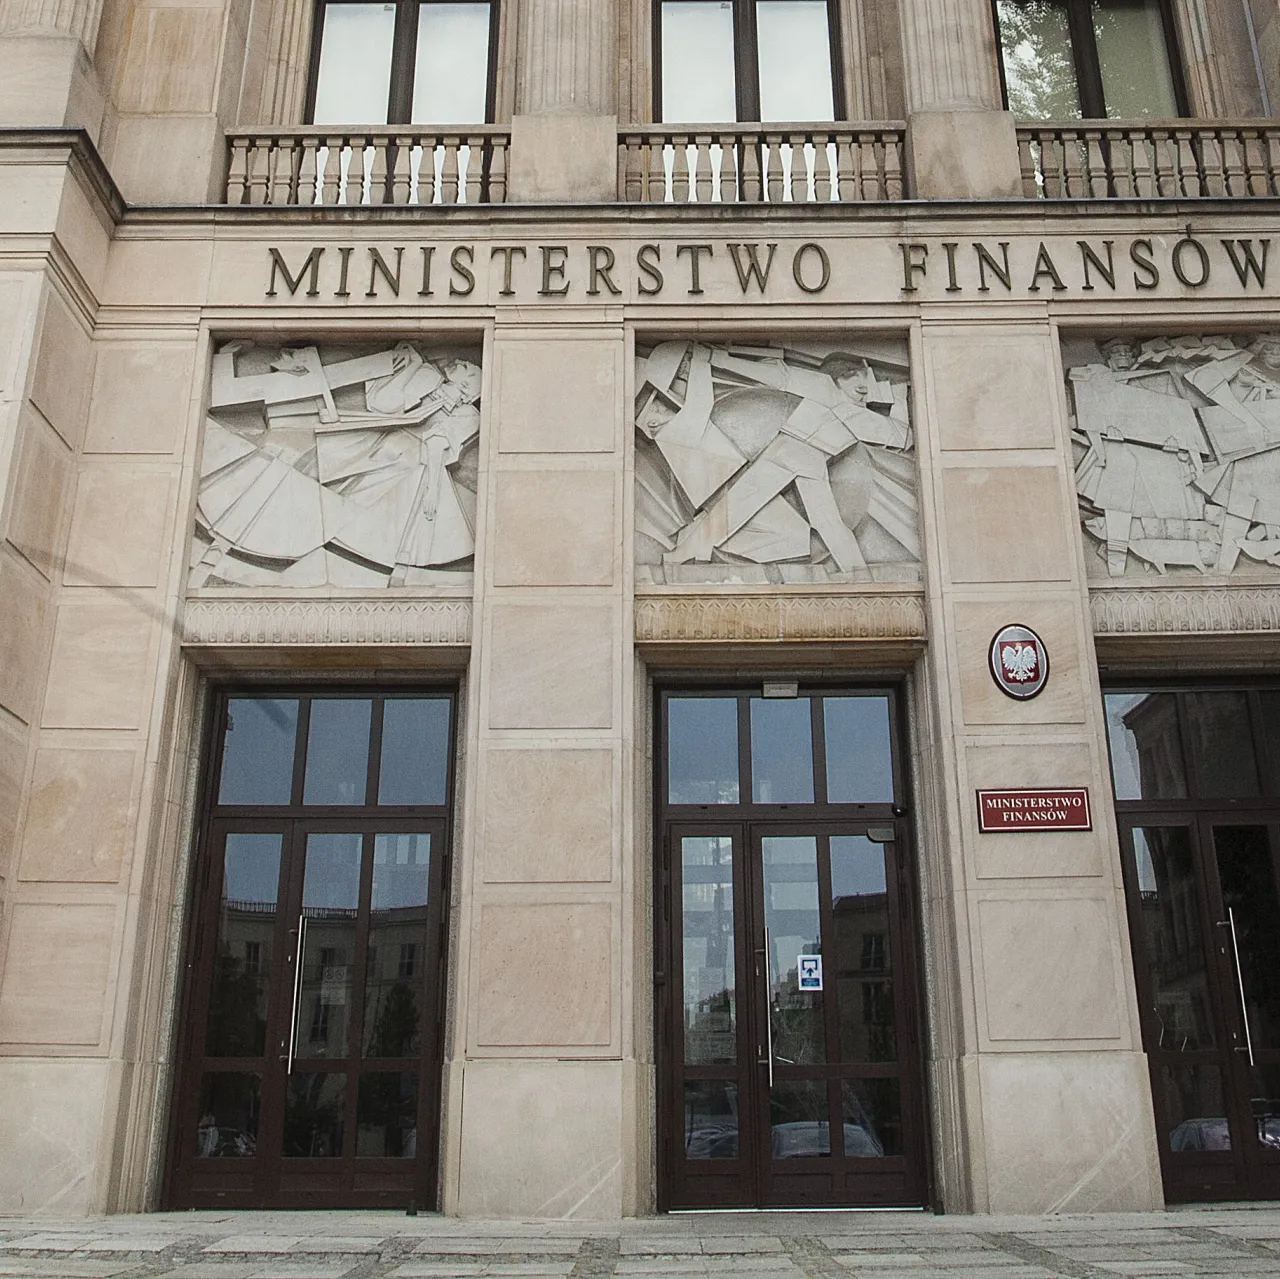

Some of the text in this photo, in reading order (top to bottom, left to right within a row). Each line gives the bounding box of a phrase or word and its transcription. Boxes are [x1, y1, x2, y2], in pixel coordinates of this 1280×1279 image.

[265, 225, 1272, 296] MINISTERSTWO FINANSÓW
[986, 797, 1082, 808] MINISTERSTWO
[1003, 808, 1068, 821] FINANSÓW
